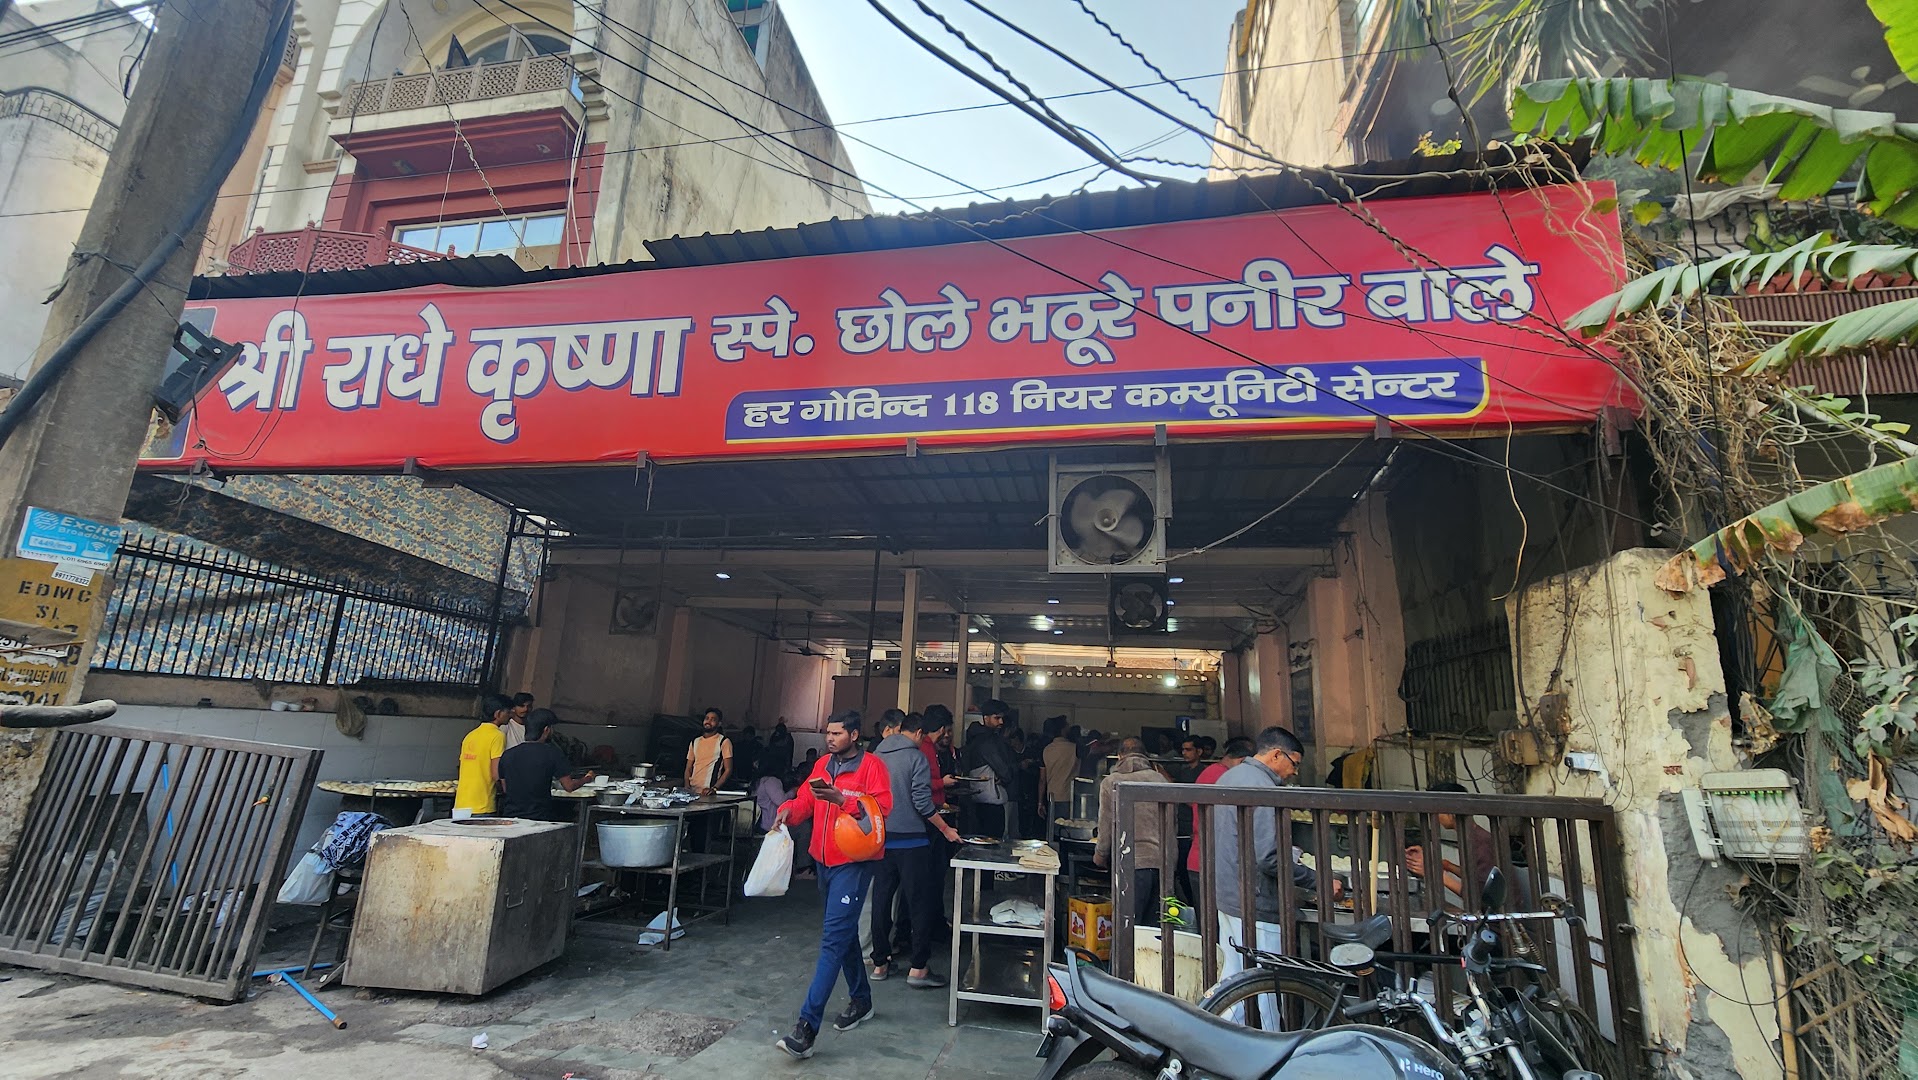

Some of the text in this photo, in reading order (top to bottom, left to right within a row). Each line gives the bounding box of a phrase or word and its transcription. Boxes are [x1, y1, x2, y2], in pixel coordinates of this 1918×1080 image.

[219, 243, 1540, 442] श्री राधे कृष्णा स्पे. छोले भठूरे पनीर वाले
[743, 366, 1460, 428] हर गोविन्द 118 नियर कम्यूनिटी सेन्टर
[60, 516, 121, 538] Excite
[18, 580, 92, 603] EDMC
[1414, 1062, 1445, 1080] Hero
